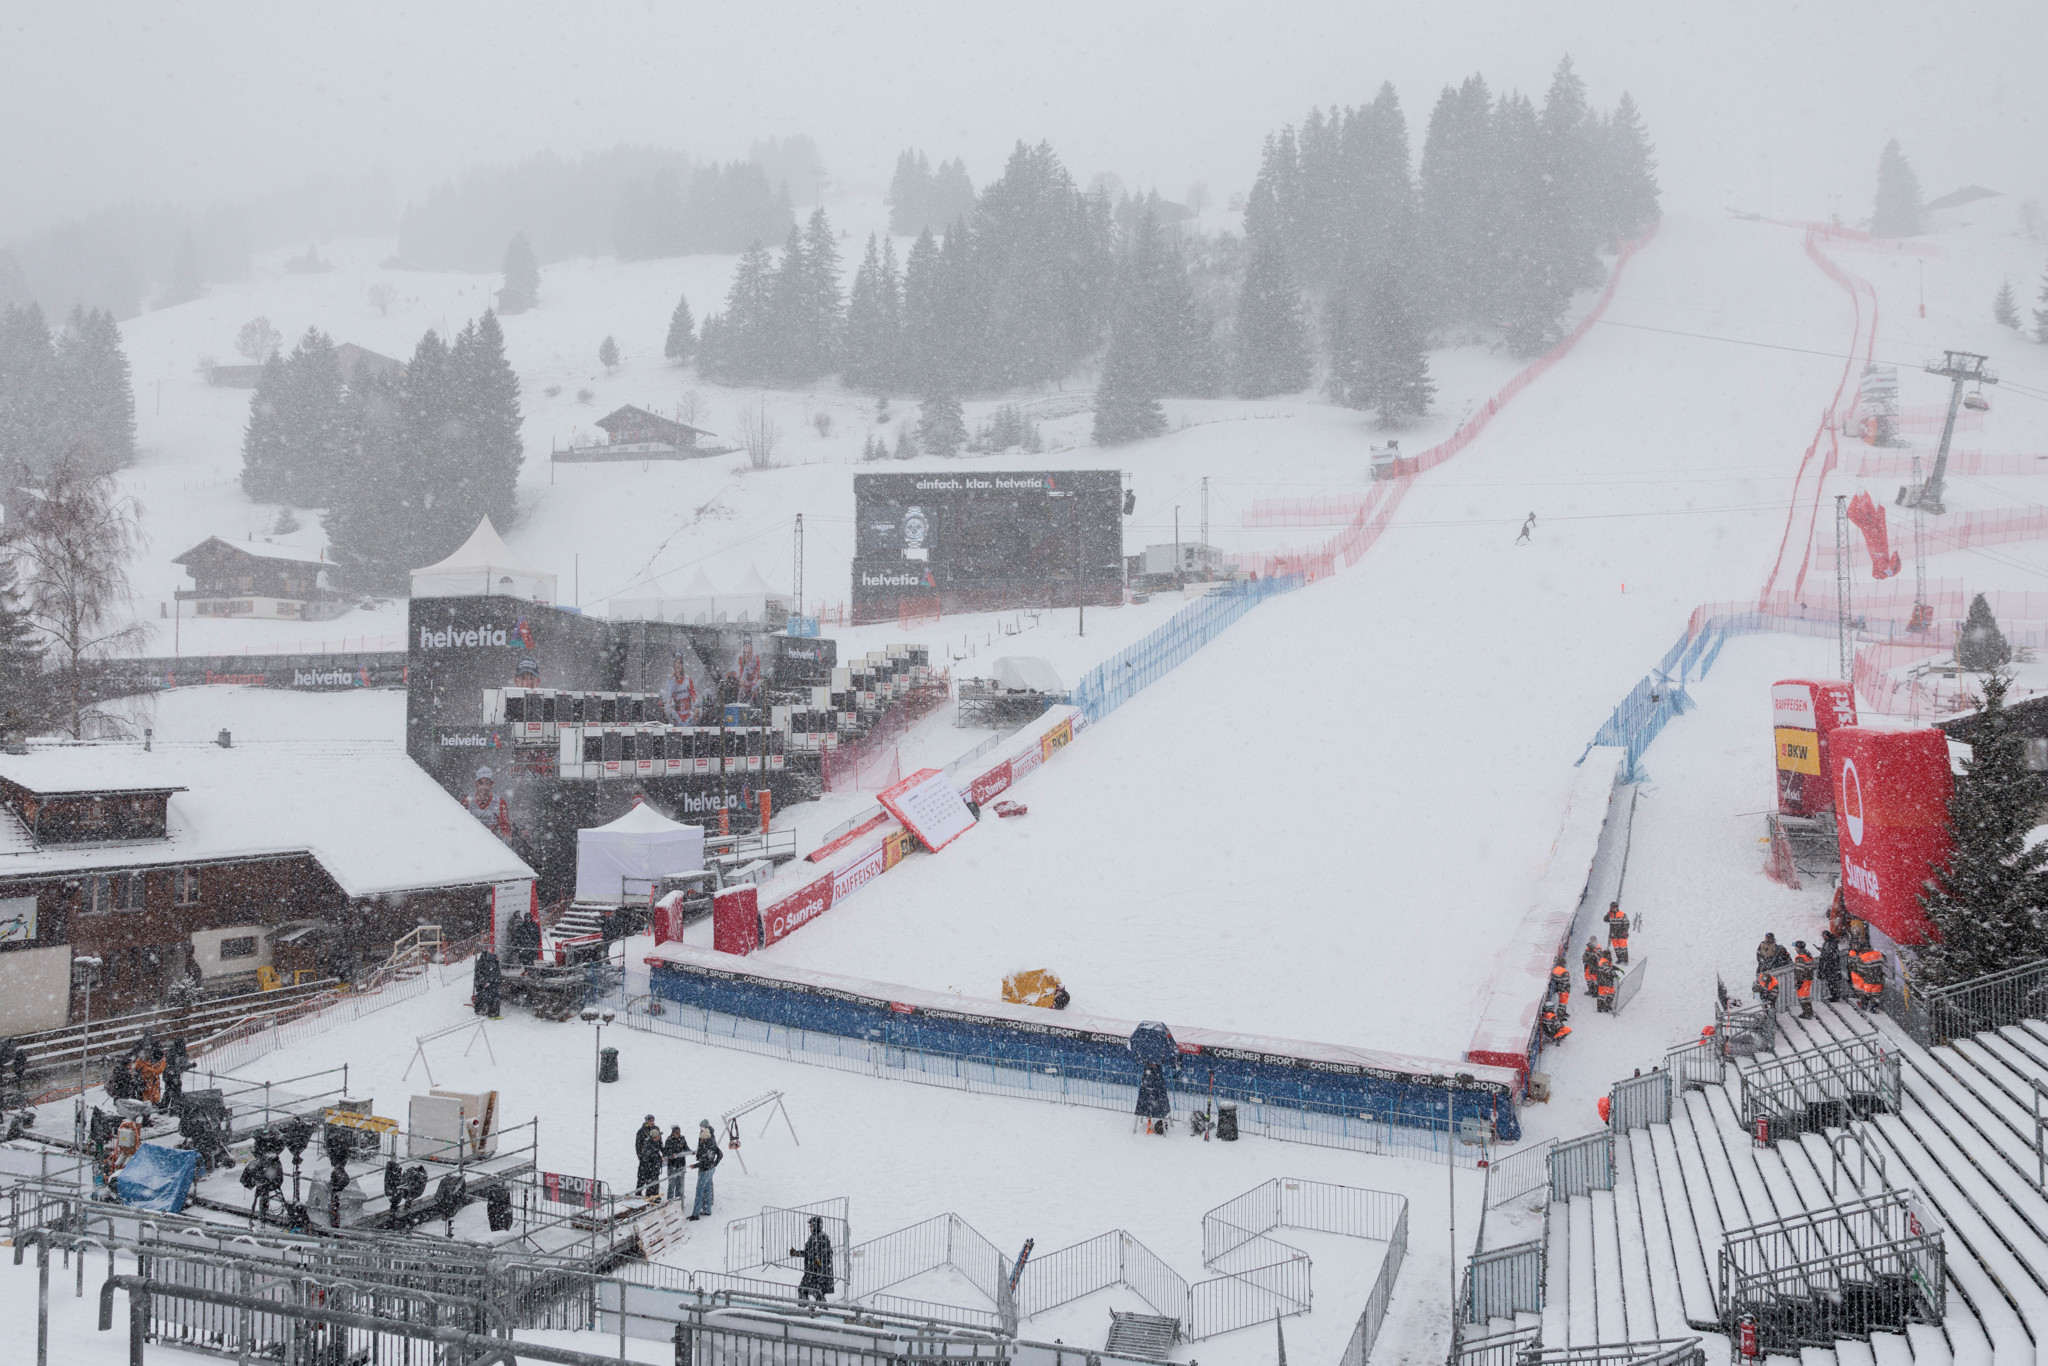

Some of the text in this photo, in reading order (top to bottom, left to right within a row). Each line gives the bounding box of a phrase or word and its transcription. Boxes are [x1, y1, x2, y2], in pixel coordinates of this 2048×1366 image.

[916, 477, 1042, 489] einfach. klar. helvetia
[862, 571, 919, 586] helvetia
[420, 623, 507, 648] helvetia
[294, 668, 352, 686] helvetia
[1775, 698, 1808, 712] RAIFFEISEN
[441, 733, 487, 746] helvetia
[1788, 744, 1808, 760] BKW
[1013, 751, 1041, 780] RAIFFEISEN
[684, 789, 738, 812] helveia
[835, 857, 882, 902] RAIFFEISEN
[1845, 854, 1880, 901] Sunrise
[786, 898, 824, 931] Sunrise
[672, 962, 708, 975] OCHSNER
[709, 969, 735, 980] SPORT
[744, 975, 810, 993] OCHSNER SPORT
[818, 987, 856, 1001] OCHSNER
[858, 995, 886, 1008] SPORT
[924, 1008, 995, 1026] OCHSNER SPORT
[1005, 1020, 1081, 1039] OCHSNER SPORT
[1213, 1048, 1261, 1062] OCHSNER
[1263, 1054, 1298, 1066] SPORT
[1310, 1061, 1360, 1074] OCHSNER
